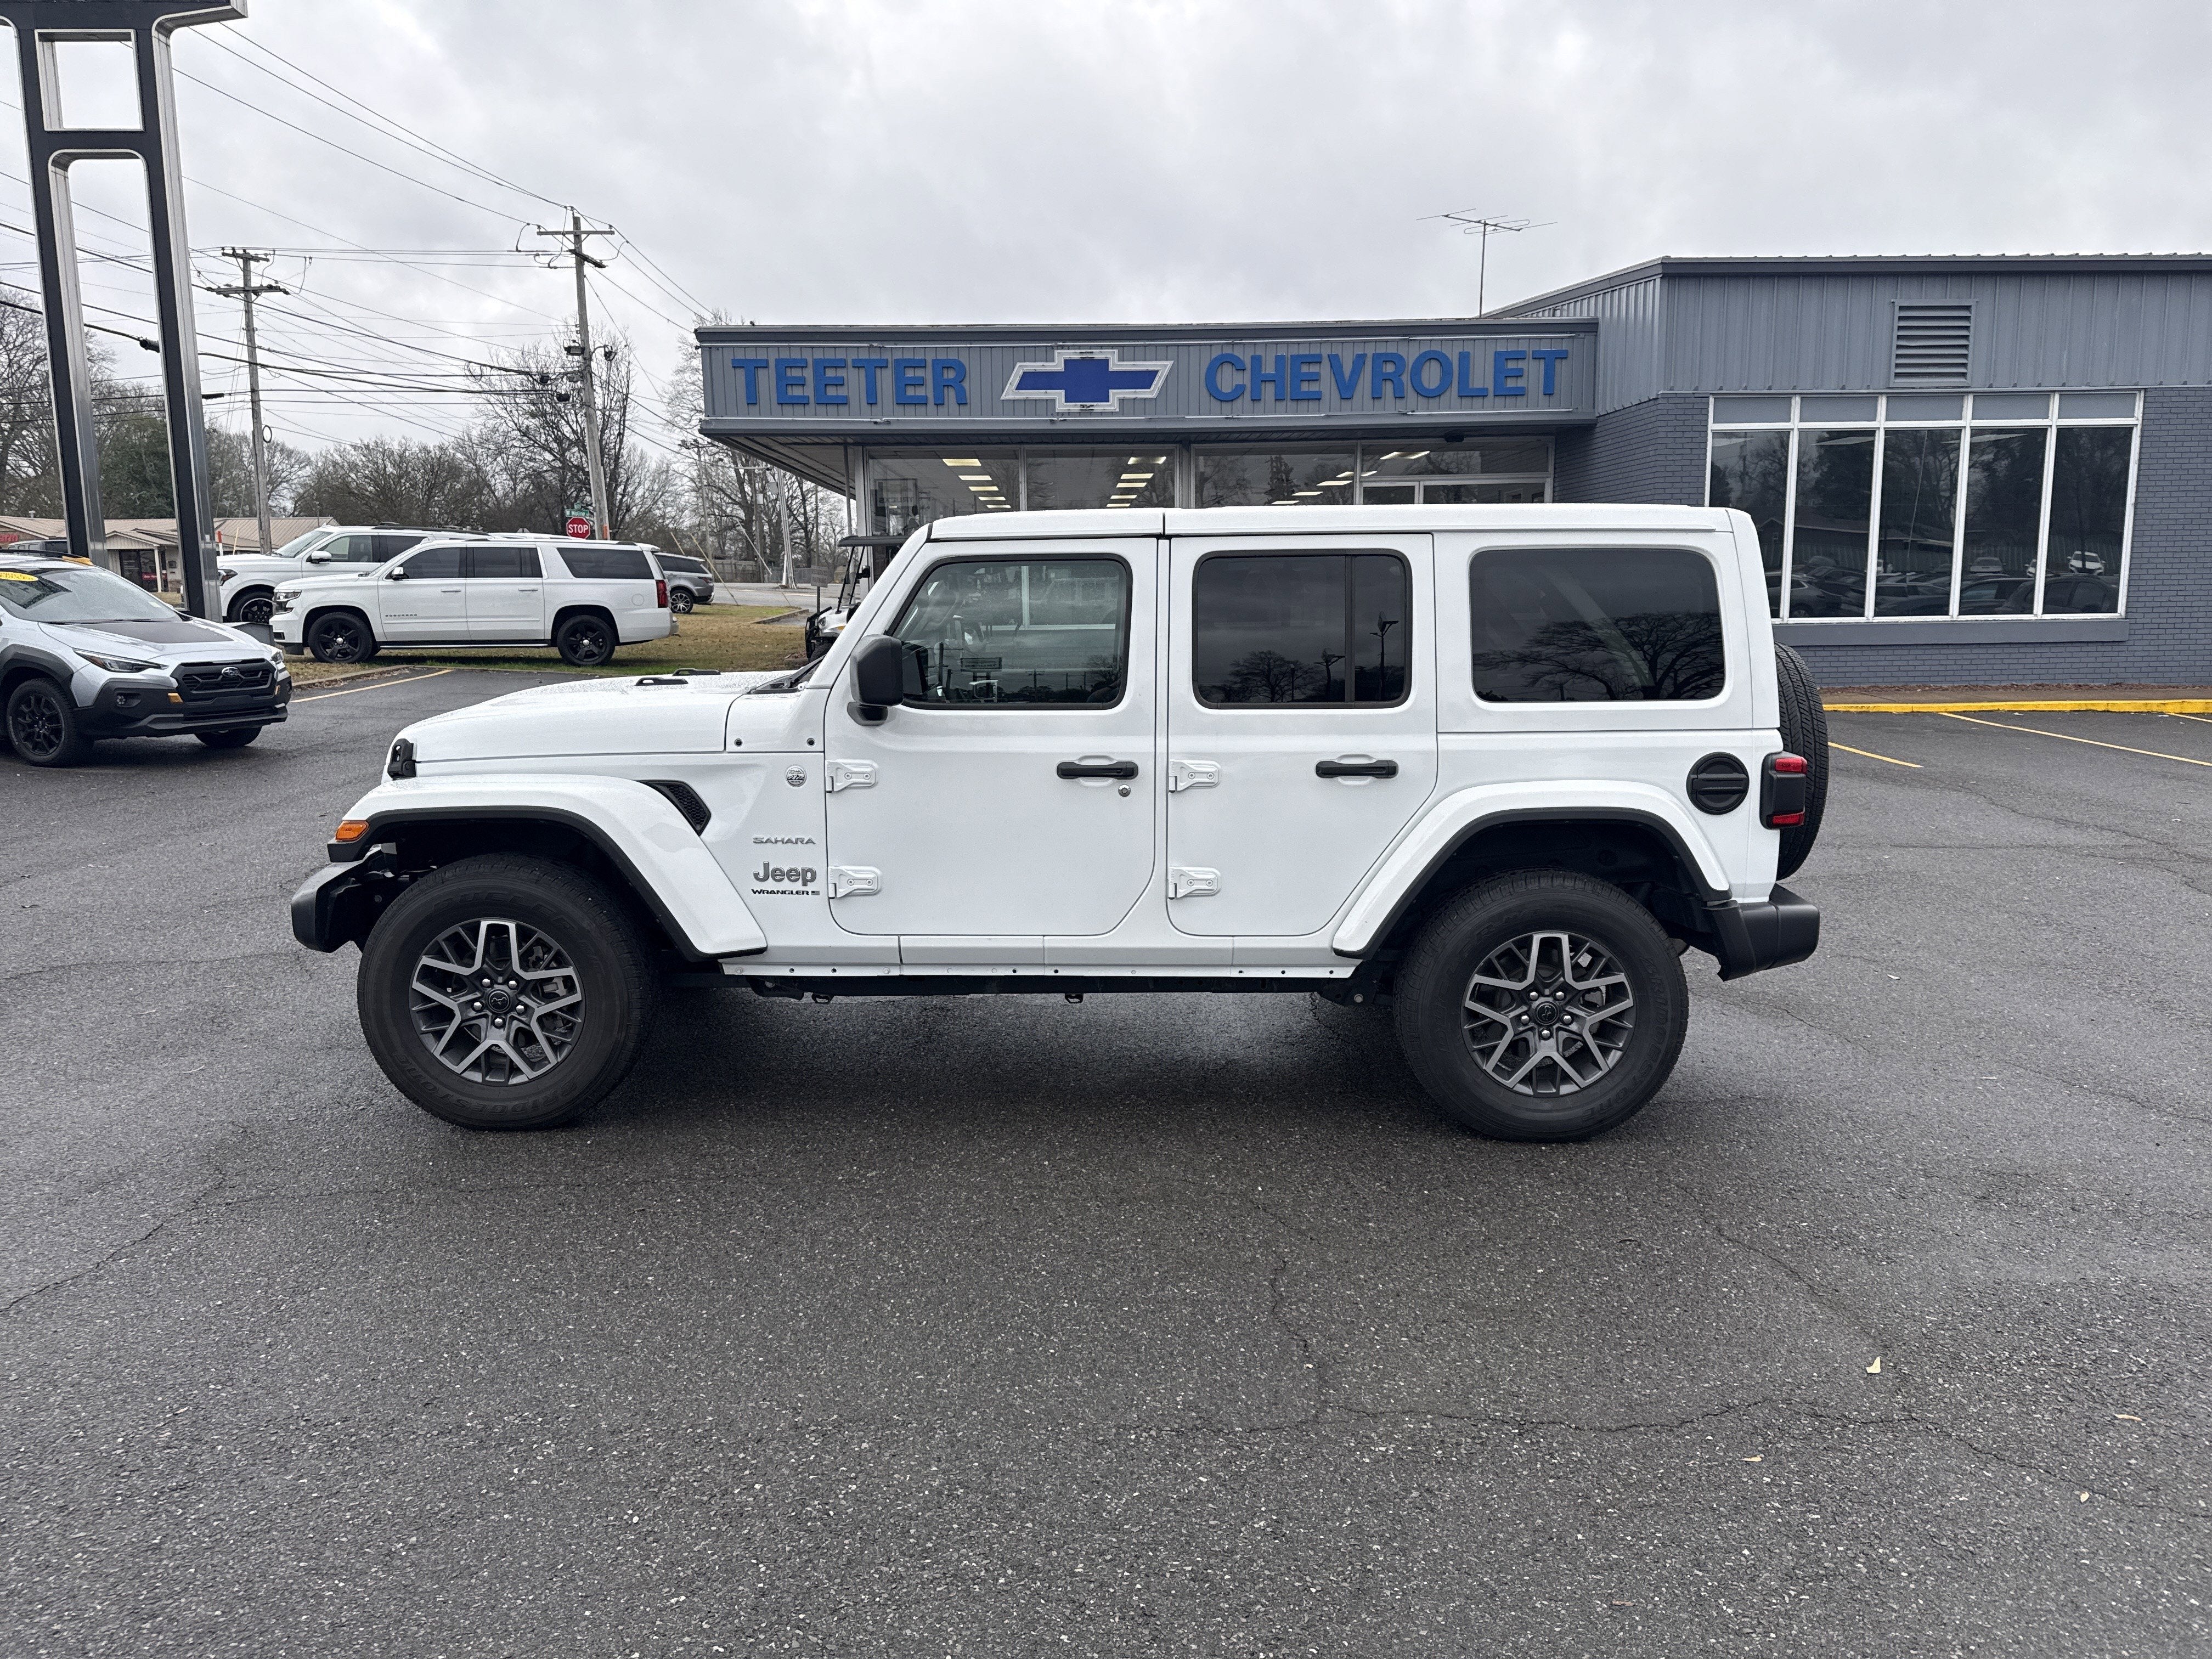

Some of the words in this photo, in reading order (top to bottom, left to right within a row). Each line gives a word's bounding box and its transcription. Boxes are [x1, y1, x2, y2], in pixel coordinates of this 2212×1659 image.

[731, 358, 968, 405] TEETER
[1205, 349, 1569, 401] CHEVROLET
[568, 524, 589, 534] STOP
[753, 861, 817, 887] Jeep
